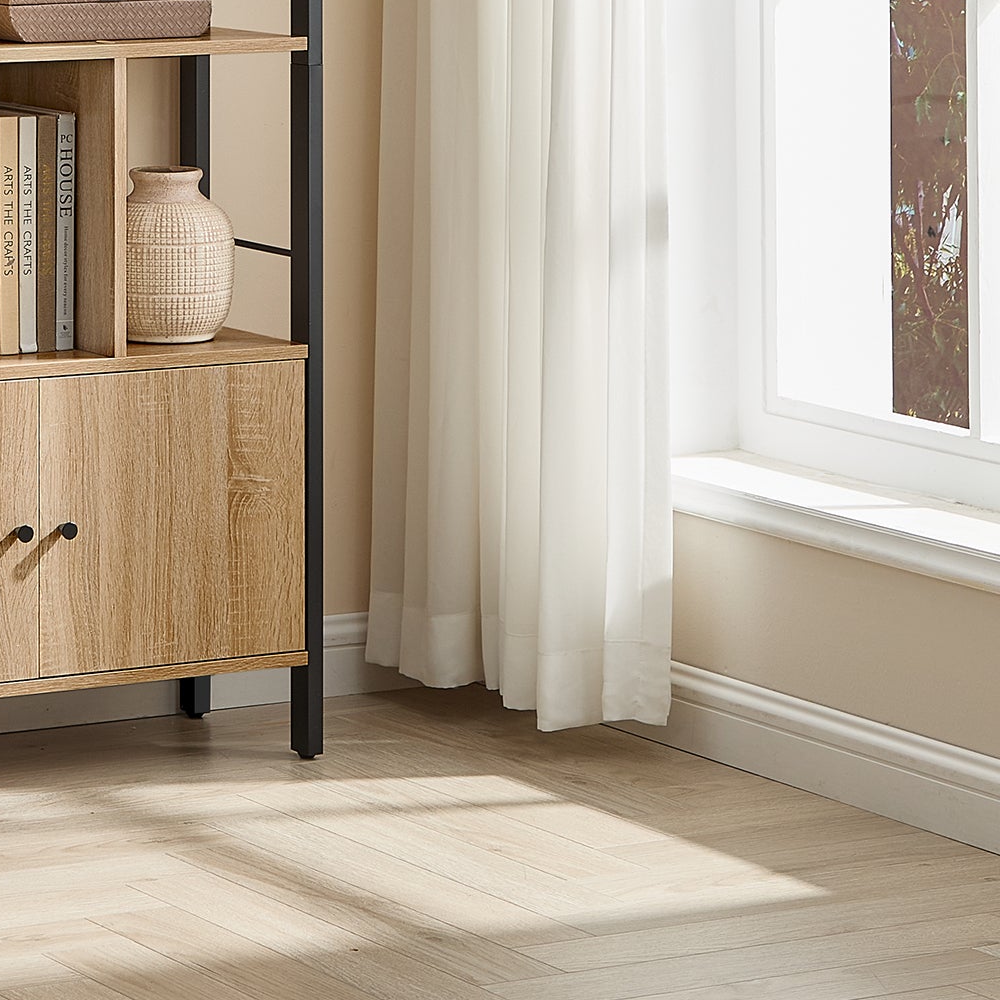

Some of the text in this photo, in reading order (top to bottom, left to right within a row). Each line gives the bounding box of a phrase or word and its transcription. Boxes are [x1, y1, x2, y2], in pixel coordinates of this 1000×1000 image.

[60, 134, 73, 144] PC
[42, 164, 52, 195] ARTS
[60, 149, 73, 218] HOUSE
[4, 165, 15, 276] ARTS THE CRAFTS
[22, 165, 33, 276] ARTS THE CRAFTS
[42, 201, 51, 222] THE
